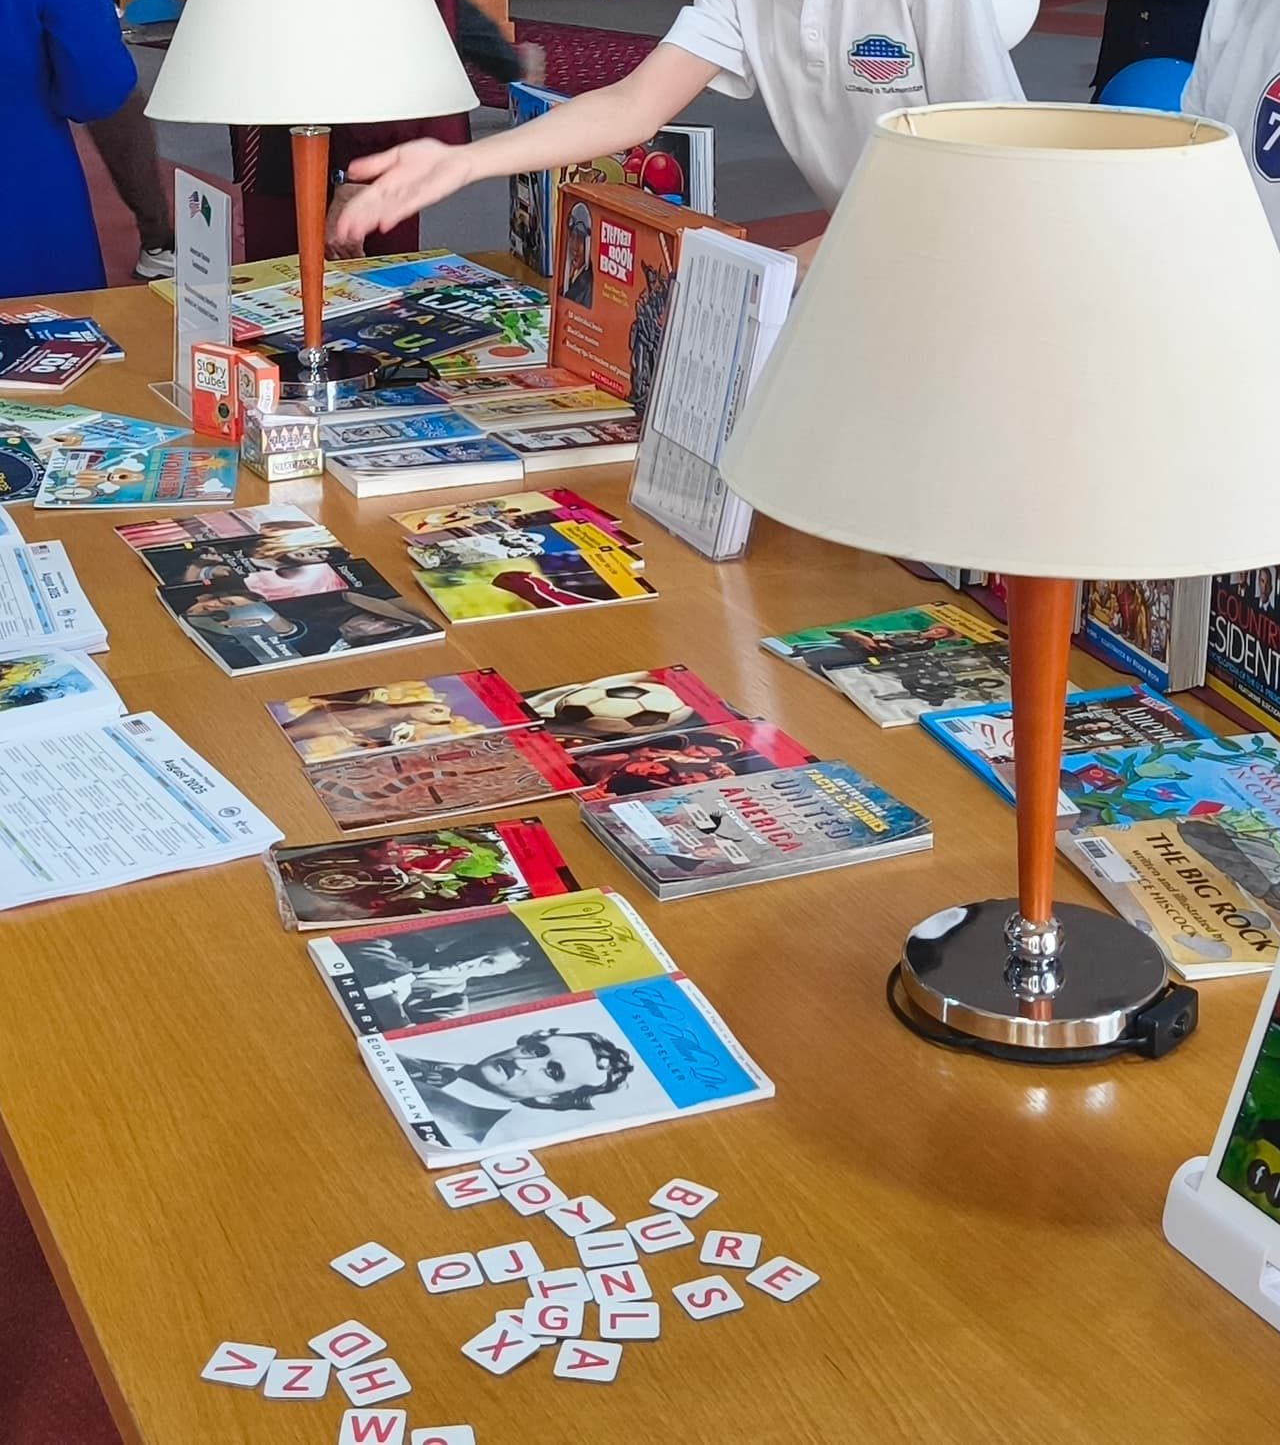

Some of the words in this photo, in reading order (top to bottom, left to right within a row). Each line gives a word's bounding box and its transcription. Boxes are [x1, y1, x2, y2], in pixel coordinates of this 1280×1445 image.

[600, 256, 627, 282] BOX
[197, 372, 227, 390] Cubes
[806, 769, 839, 795] FACTS
[719, 785, 804, 853] AMERICA
[770, 777, 854, 840] UNITED
[1131, 848, 1161, 877] written
[1158, 874, 1179, 895] and
[1173, 887, 1220, 935] illustrated
[1211, 930, 1226, 944] by
[1145, 831, 1191, 868] THE
[1176, 867, 1223, 901] BIG
[1208, 901, 1280, 953] ROCK
[1149, 888, 1200, 939] HISCOCK
[341, 977, 380, 1036] HENRY
[631, 1013, 687, 1083] STORYTELLER
[366, 1036, 396, 1074] EDGAR
[392, 1077, 424, 1121] ALLAN
[418, 1124, 438, 1143] PO
[517, 1183, 552, 1206] O
[666, 1185, 705, 1209] B
[560, 1202, 592, 1226] Y
[639, 1221, 682, 1242] U
[715, 1236, 744, 1261] R
[348, 1254, 389, 1277] F
[430, 1261, 472, 1286] Q
[504, 1249, 525, 1275] J
[600, 1272, 637, 1297] N
[763, 1265, 802, 1292] E
[686, 1288, 729, 1311] S
[538, 1305, 569, 1331] G
[609, 1312, 650, 1330] L
[328, 1331, 372, 1358] D
[476, 1329, 523, 1362] X
[214, 1348, 258, 1374] V
[567, 1348, 609, 1370] A
[282, 1364, 313, 1393] Z
[349, 1366, 396, 1395] H
[351, 1416, 398, 1443] W
